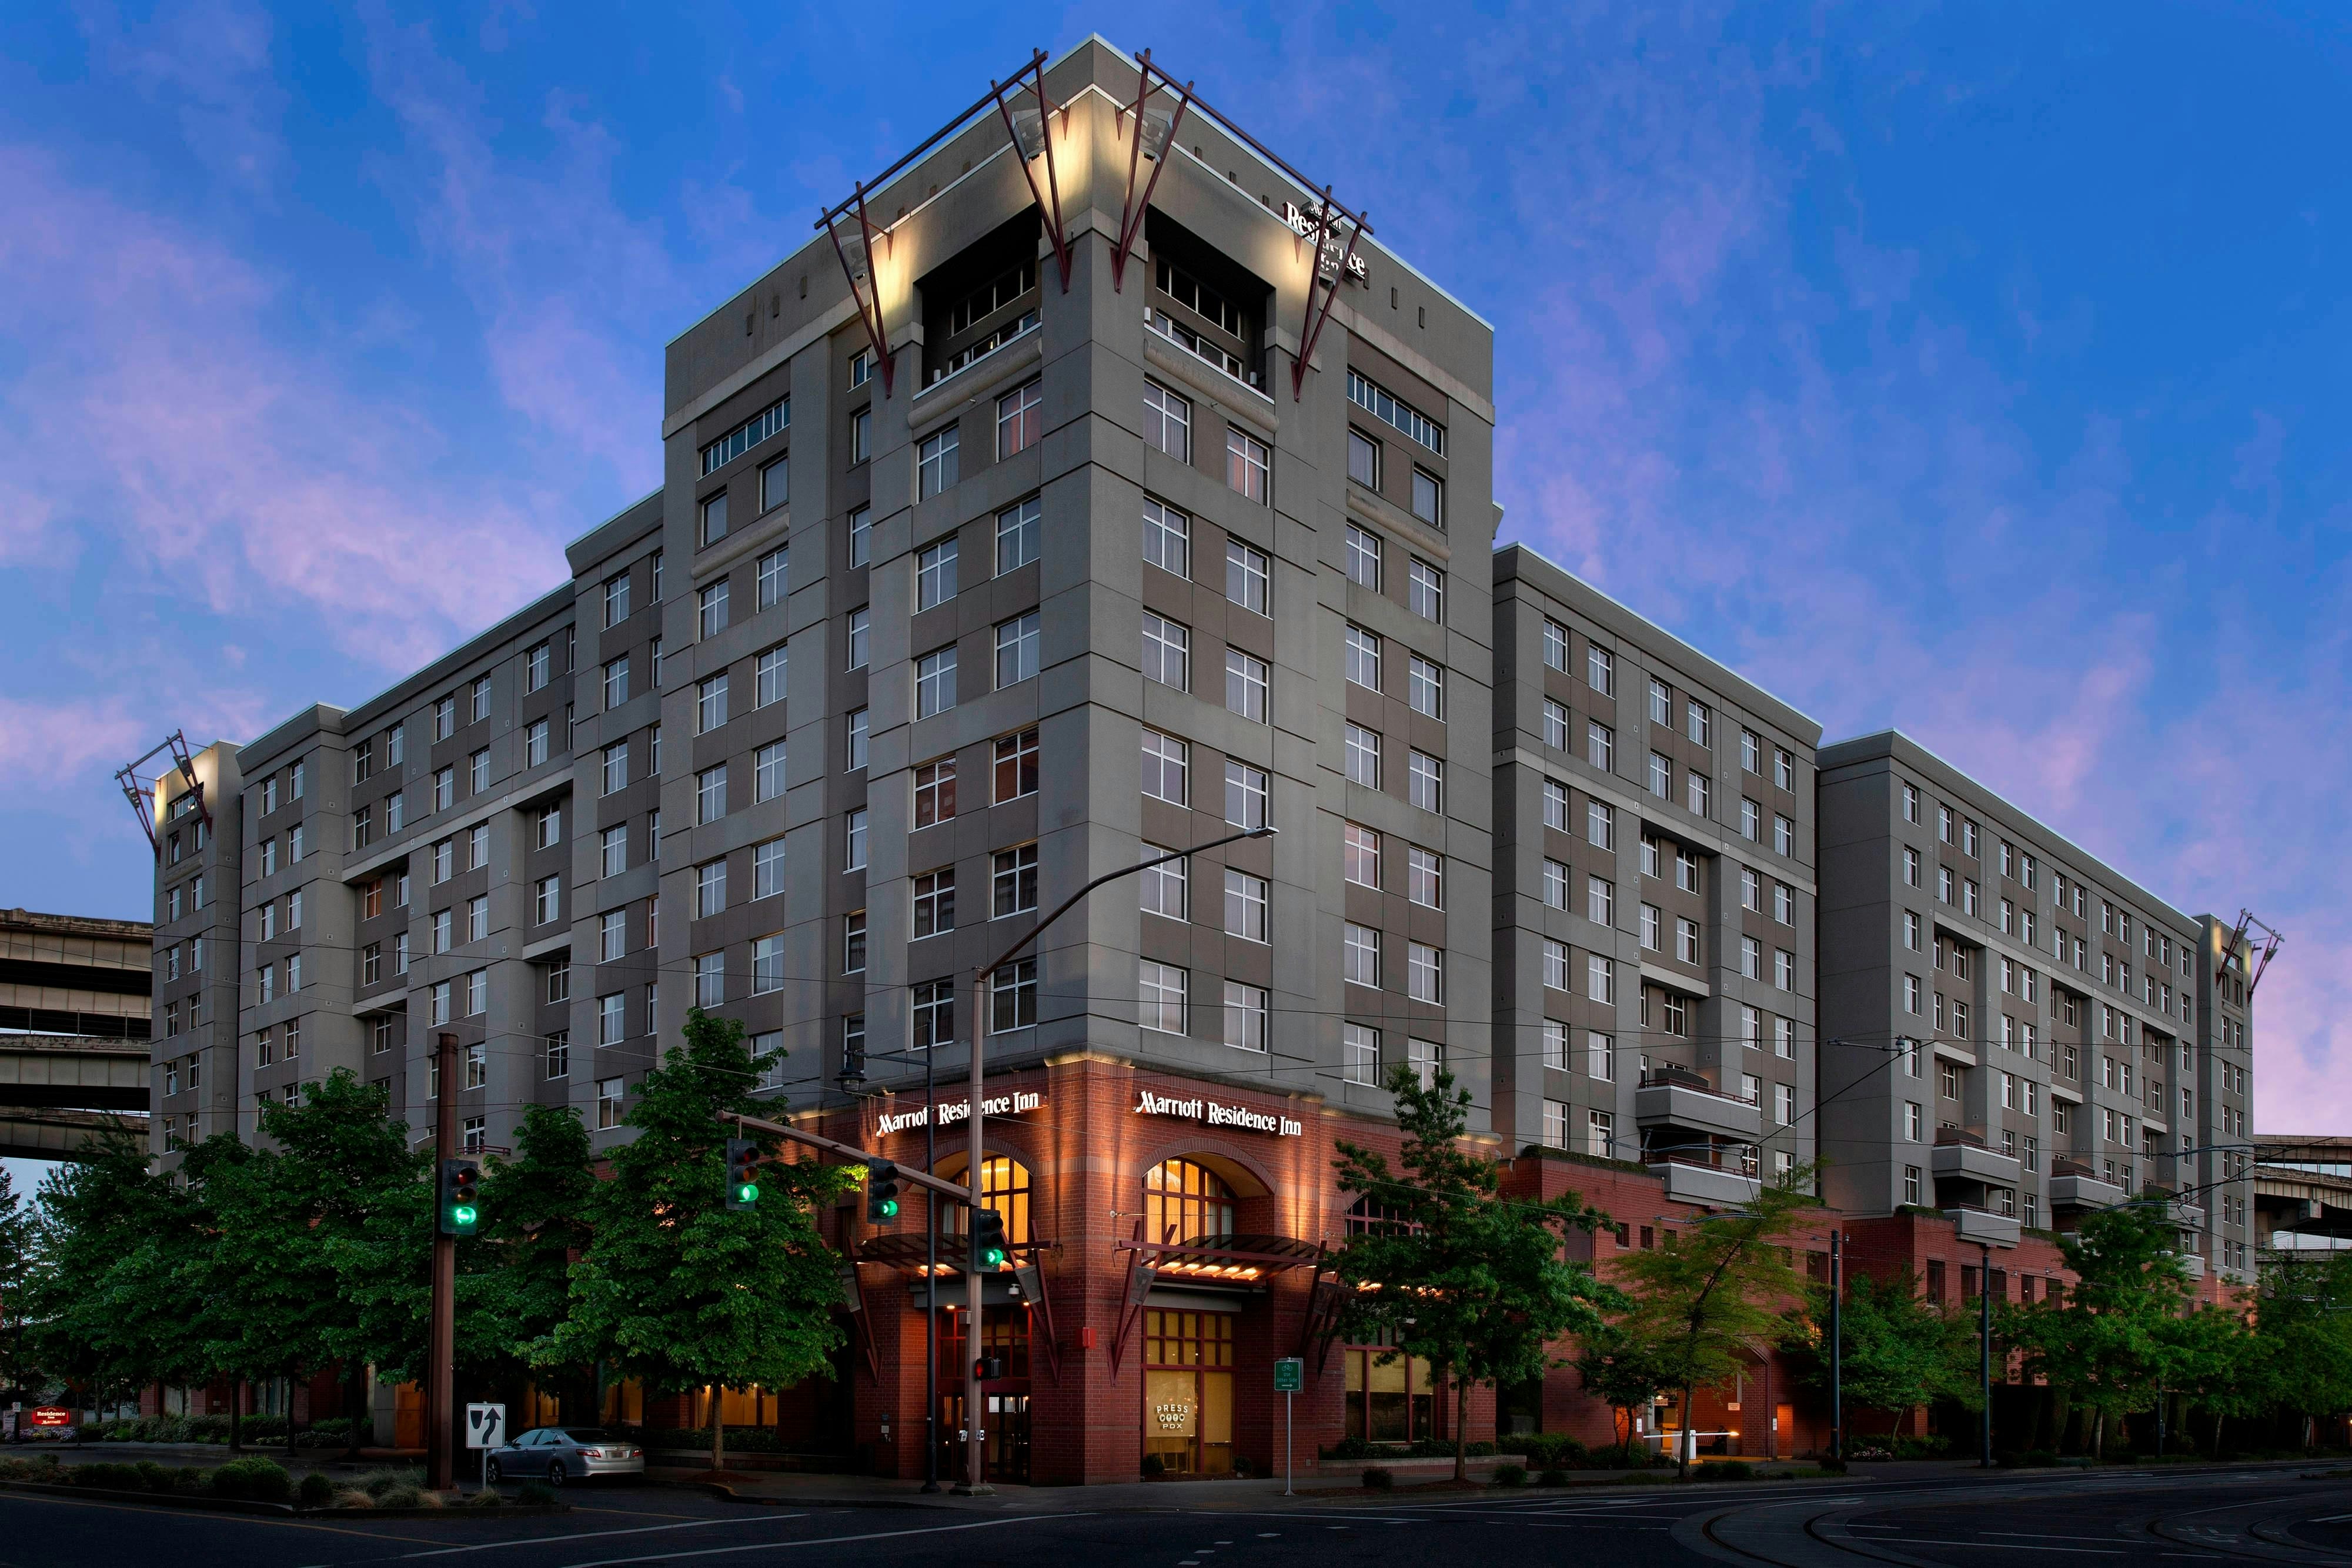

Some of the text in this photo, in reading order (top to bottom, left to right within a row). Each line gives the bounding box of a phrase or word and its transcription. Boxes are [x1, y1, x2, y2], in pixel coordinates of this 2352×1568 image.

[876, 1091, 1038, 1136] Marriot Resince Inn
[1135, 1091, 1302, 1136] Marriott Residence Inn
[1157, 1404, 1188, 1413] PRESS
